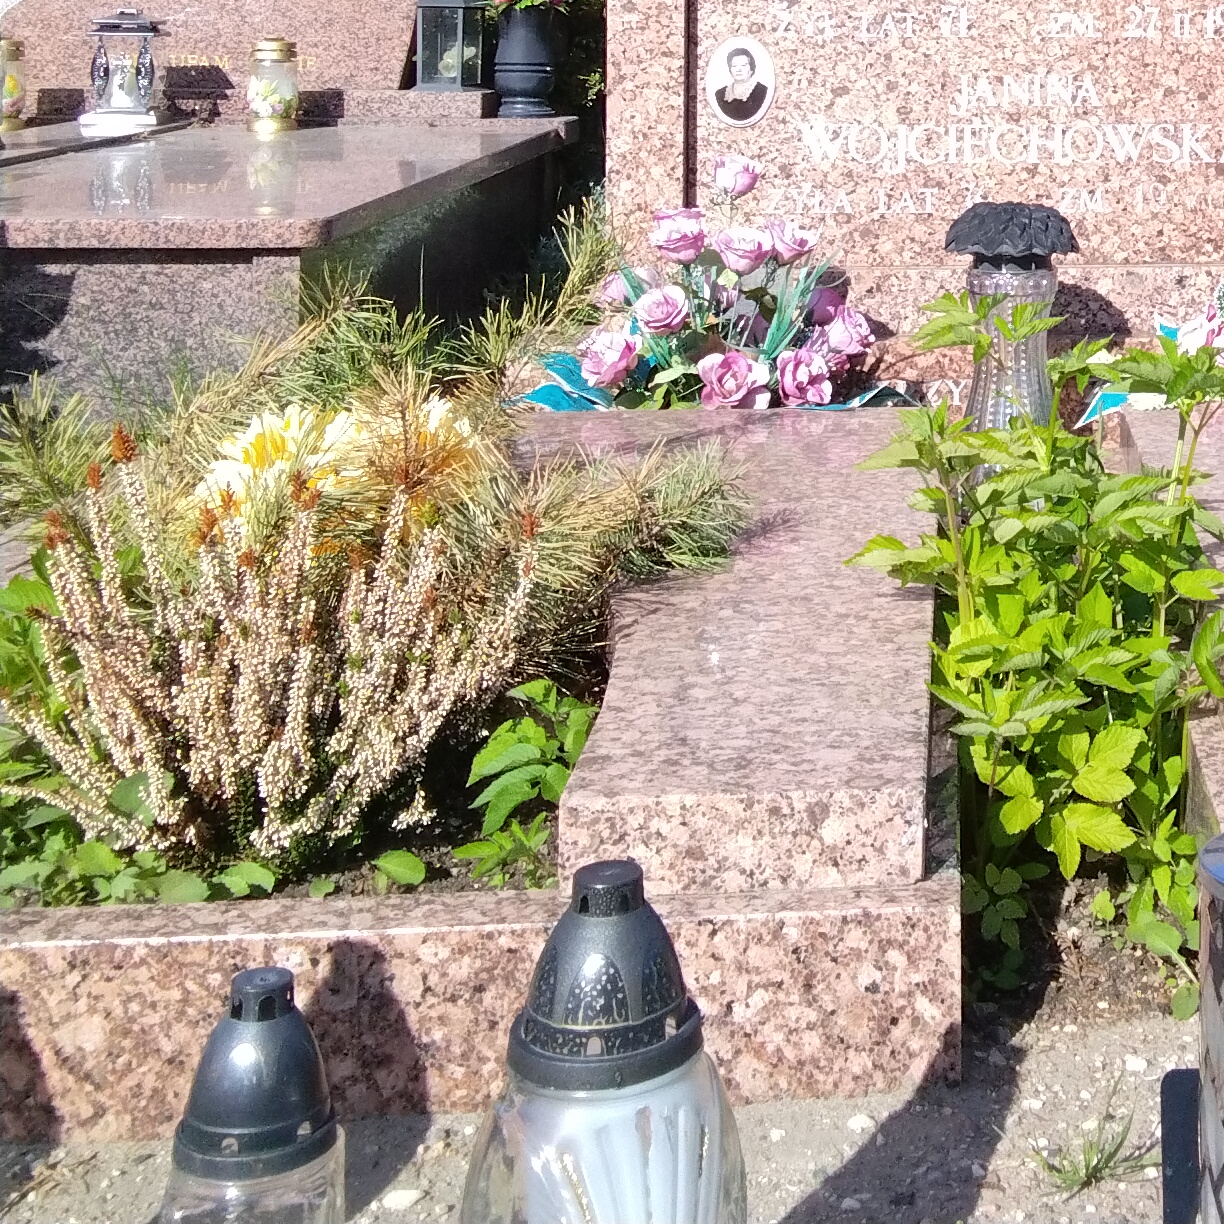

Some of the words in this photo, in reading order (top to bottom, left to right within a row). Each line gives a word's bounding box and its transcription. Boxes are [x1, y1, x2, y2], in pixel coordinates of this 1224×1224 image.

[860, 11, 919, 38] LAT
[1121, 4, 1160, 38] 27
[951, 73, 1102, 115] JANINA
[877, 187, 938, 214] LAT
